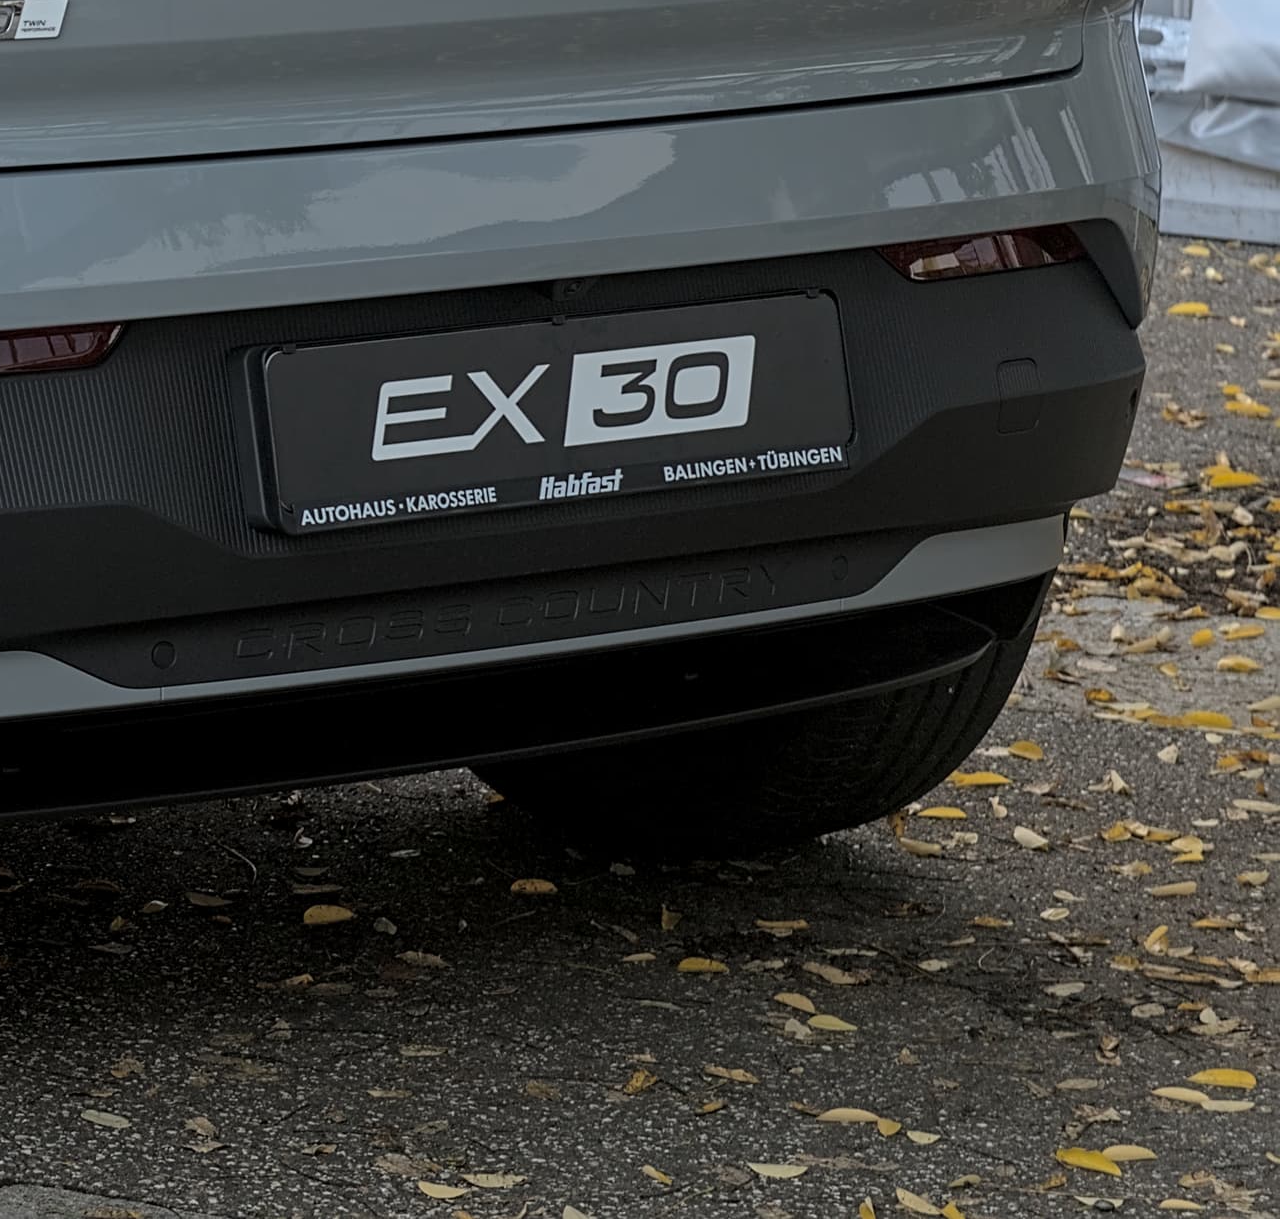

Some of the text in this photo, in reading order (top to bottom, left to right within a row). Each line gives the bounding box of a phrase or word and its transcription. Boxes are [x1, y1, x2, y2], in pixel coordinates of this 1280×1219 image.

[539, 468, 624, 500] Habfast
[234, 560, 785, 661] CROSS COUNTRY
